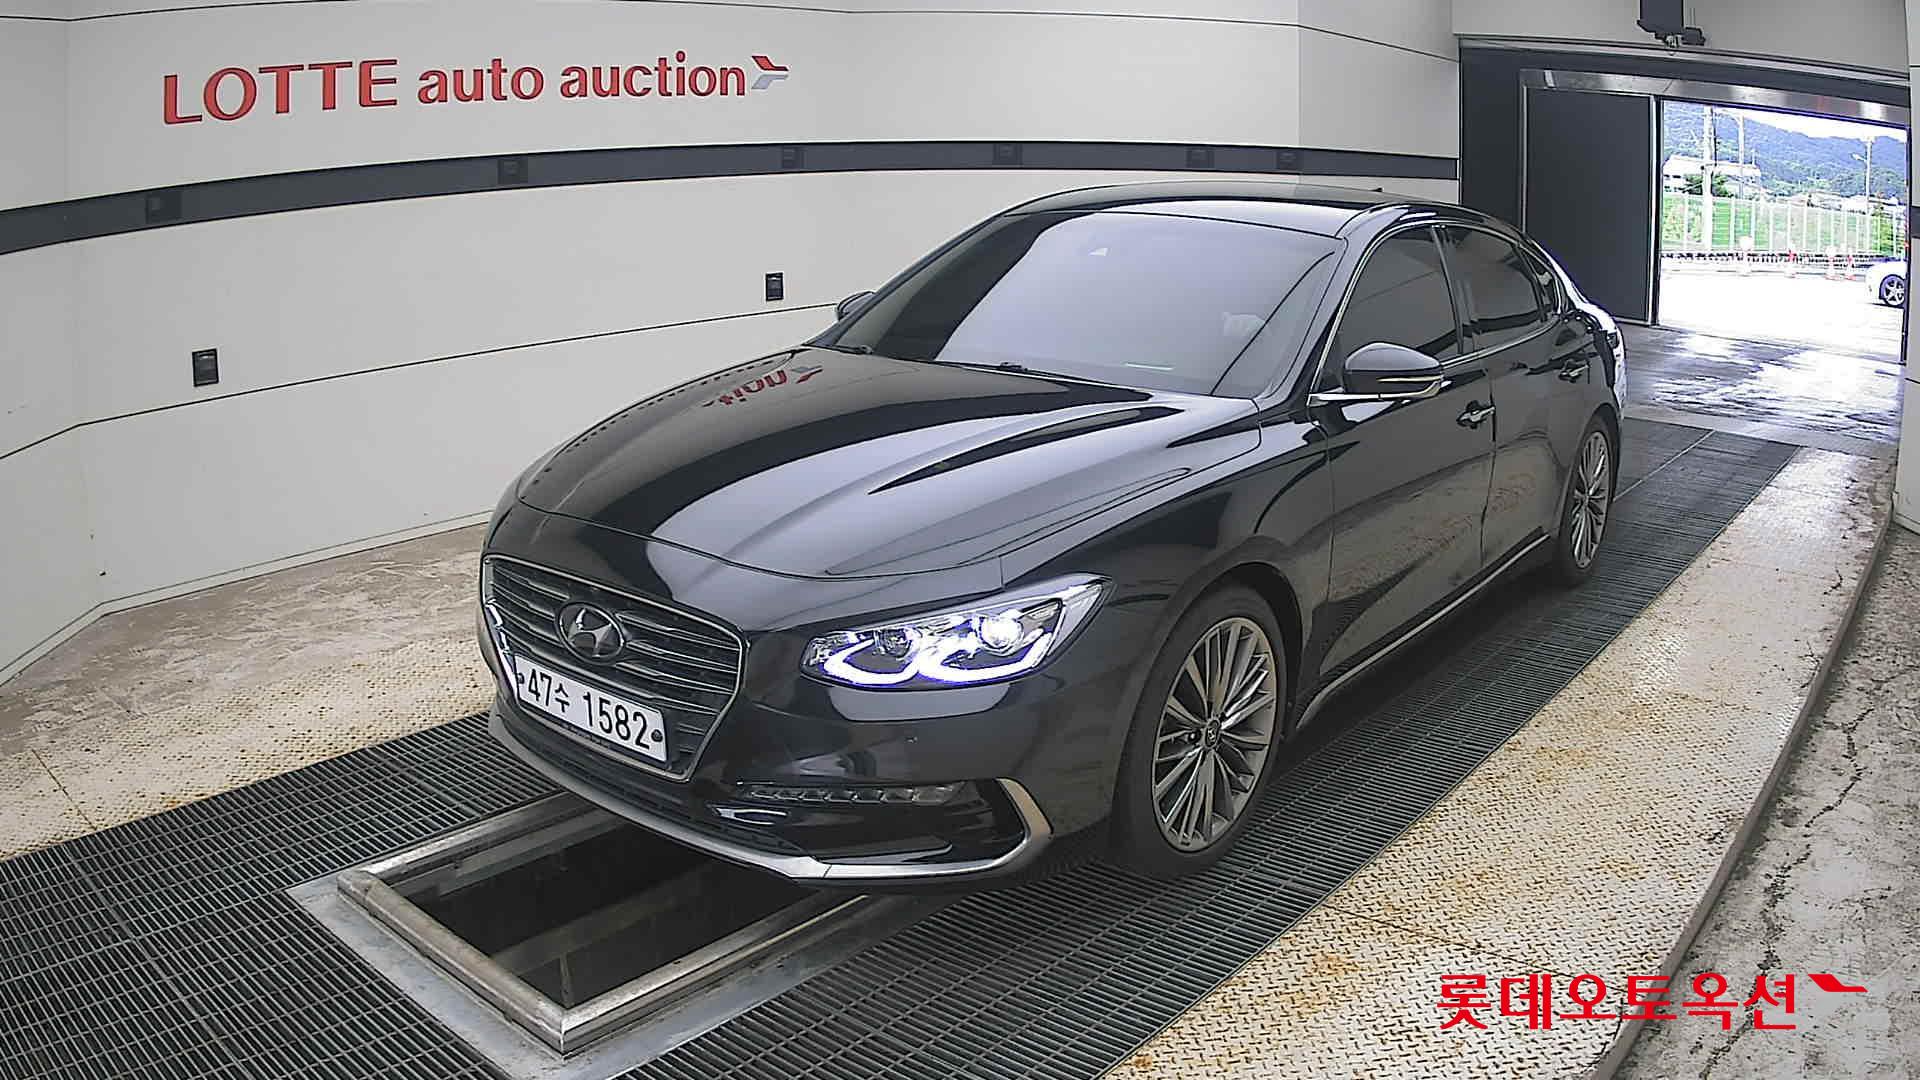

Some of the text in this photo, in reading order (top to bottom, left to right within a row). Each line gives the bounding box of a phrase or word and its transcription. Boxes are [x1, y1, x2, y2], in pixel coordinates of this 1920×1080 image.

[163, 50, 747, 126] LOTTE auto auction
[527, 667, 651, 751] 47수 1582
